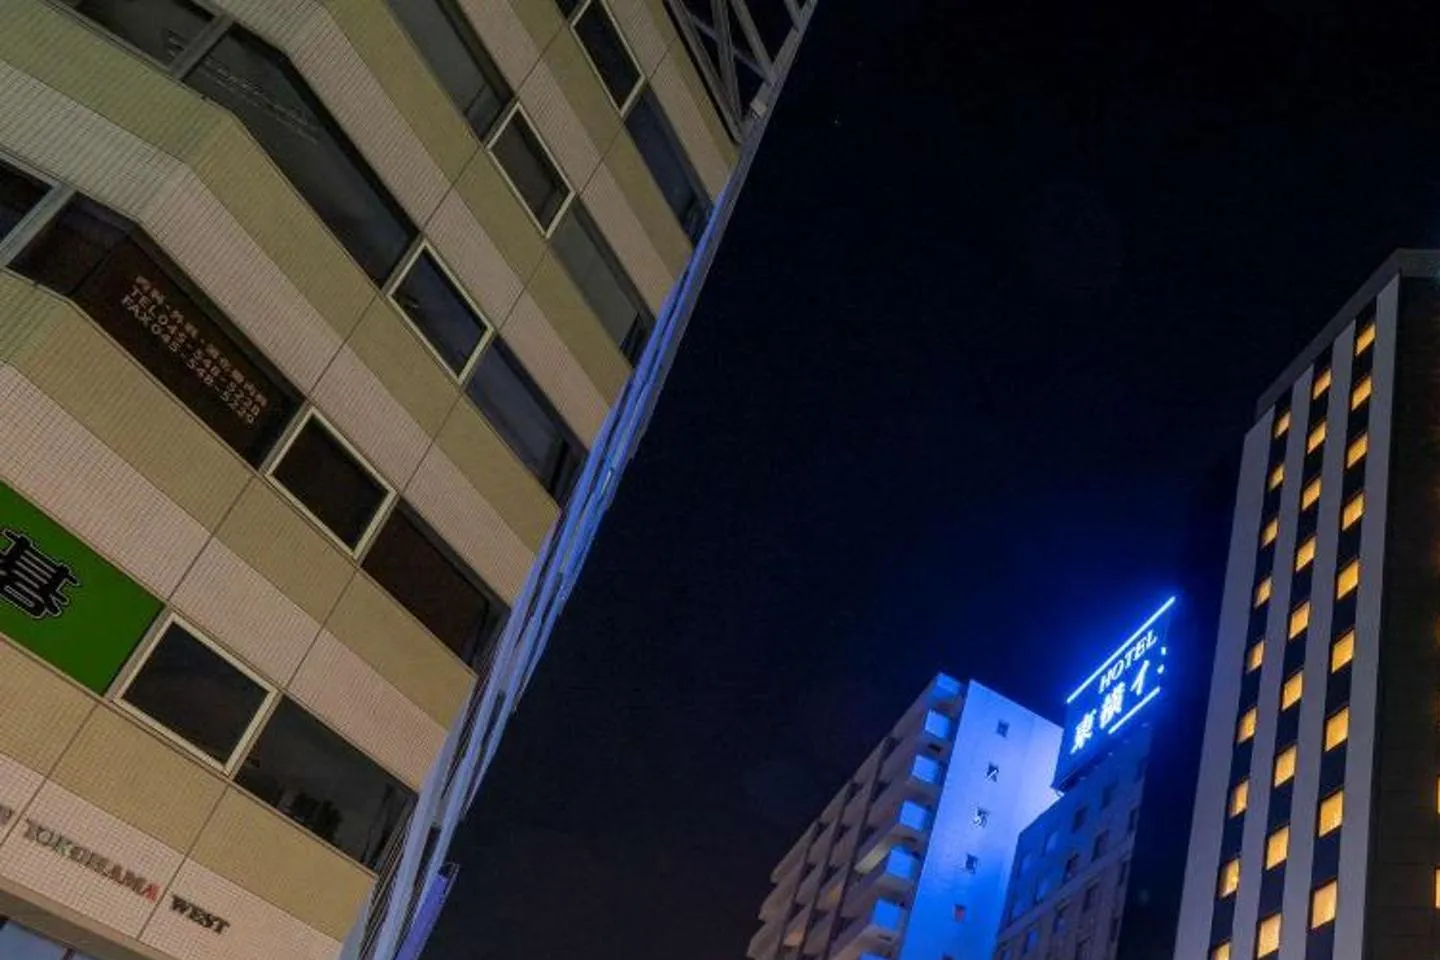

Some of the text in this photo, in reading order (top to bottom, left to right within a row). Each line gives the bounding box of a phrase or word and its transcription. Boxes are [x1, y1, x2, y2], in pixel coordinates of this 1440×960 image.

[1098, 629, 1157, 693] HOTEL
[1070, 646, 1167, 754] 東横イ
[168, 894, 231, 935] WEST
